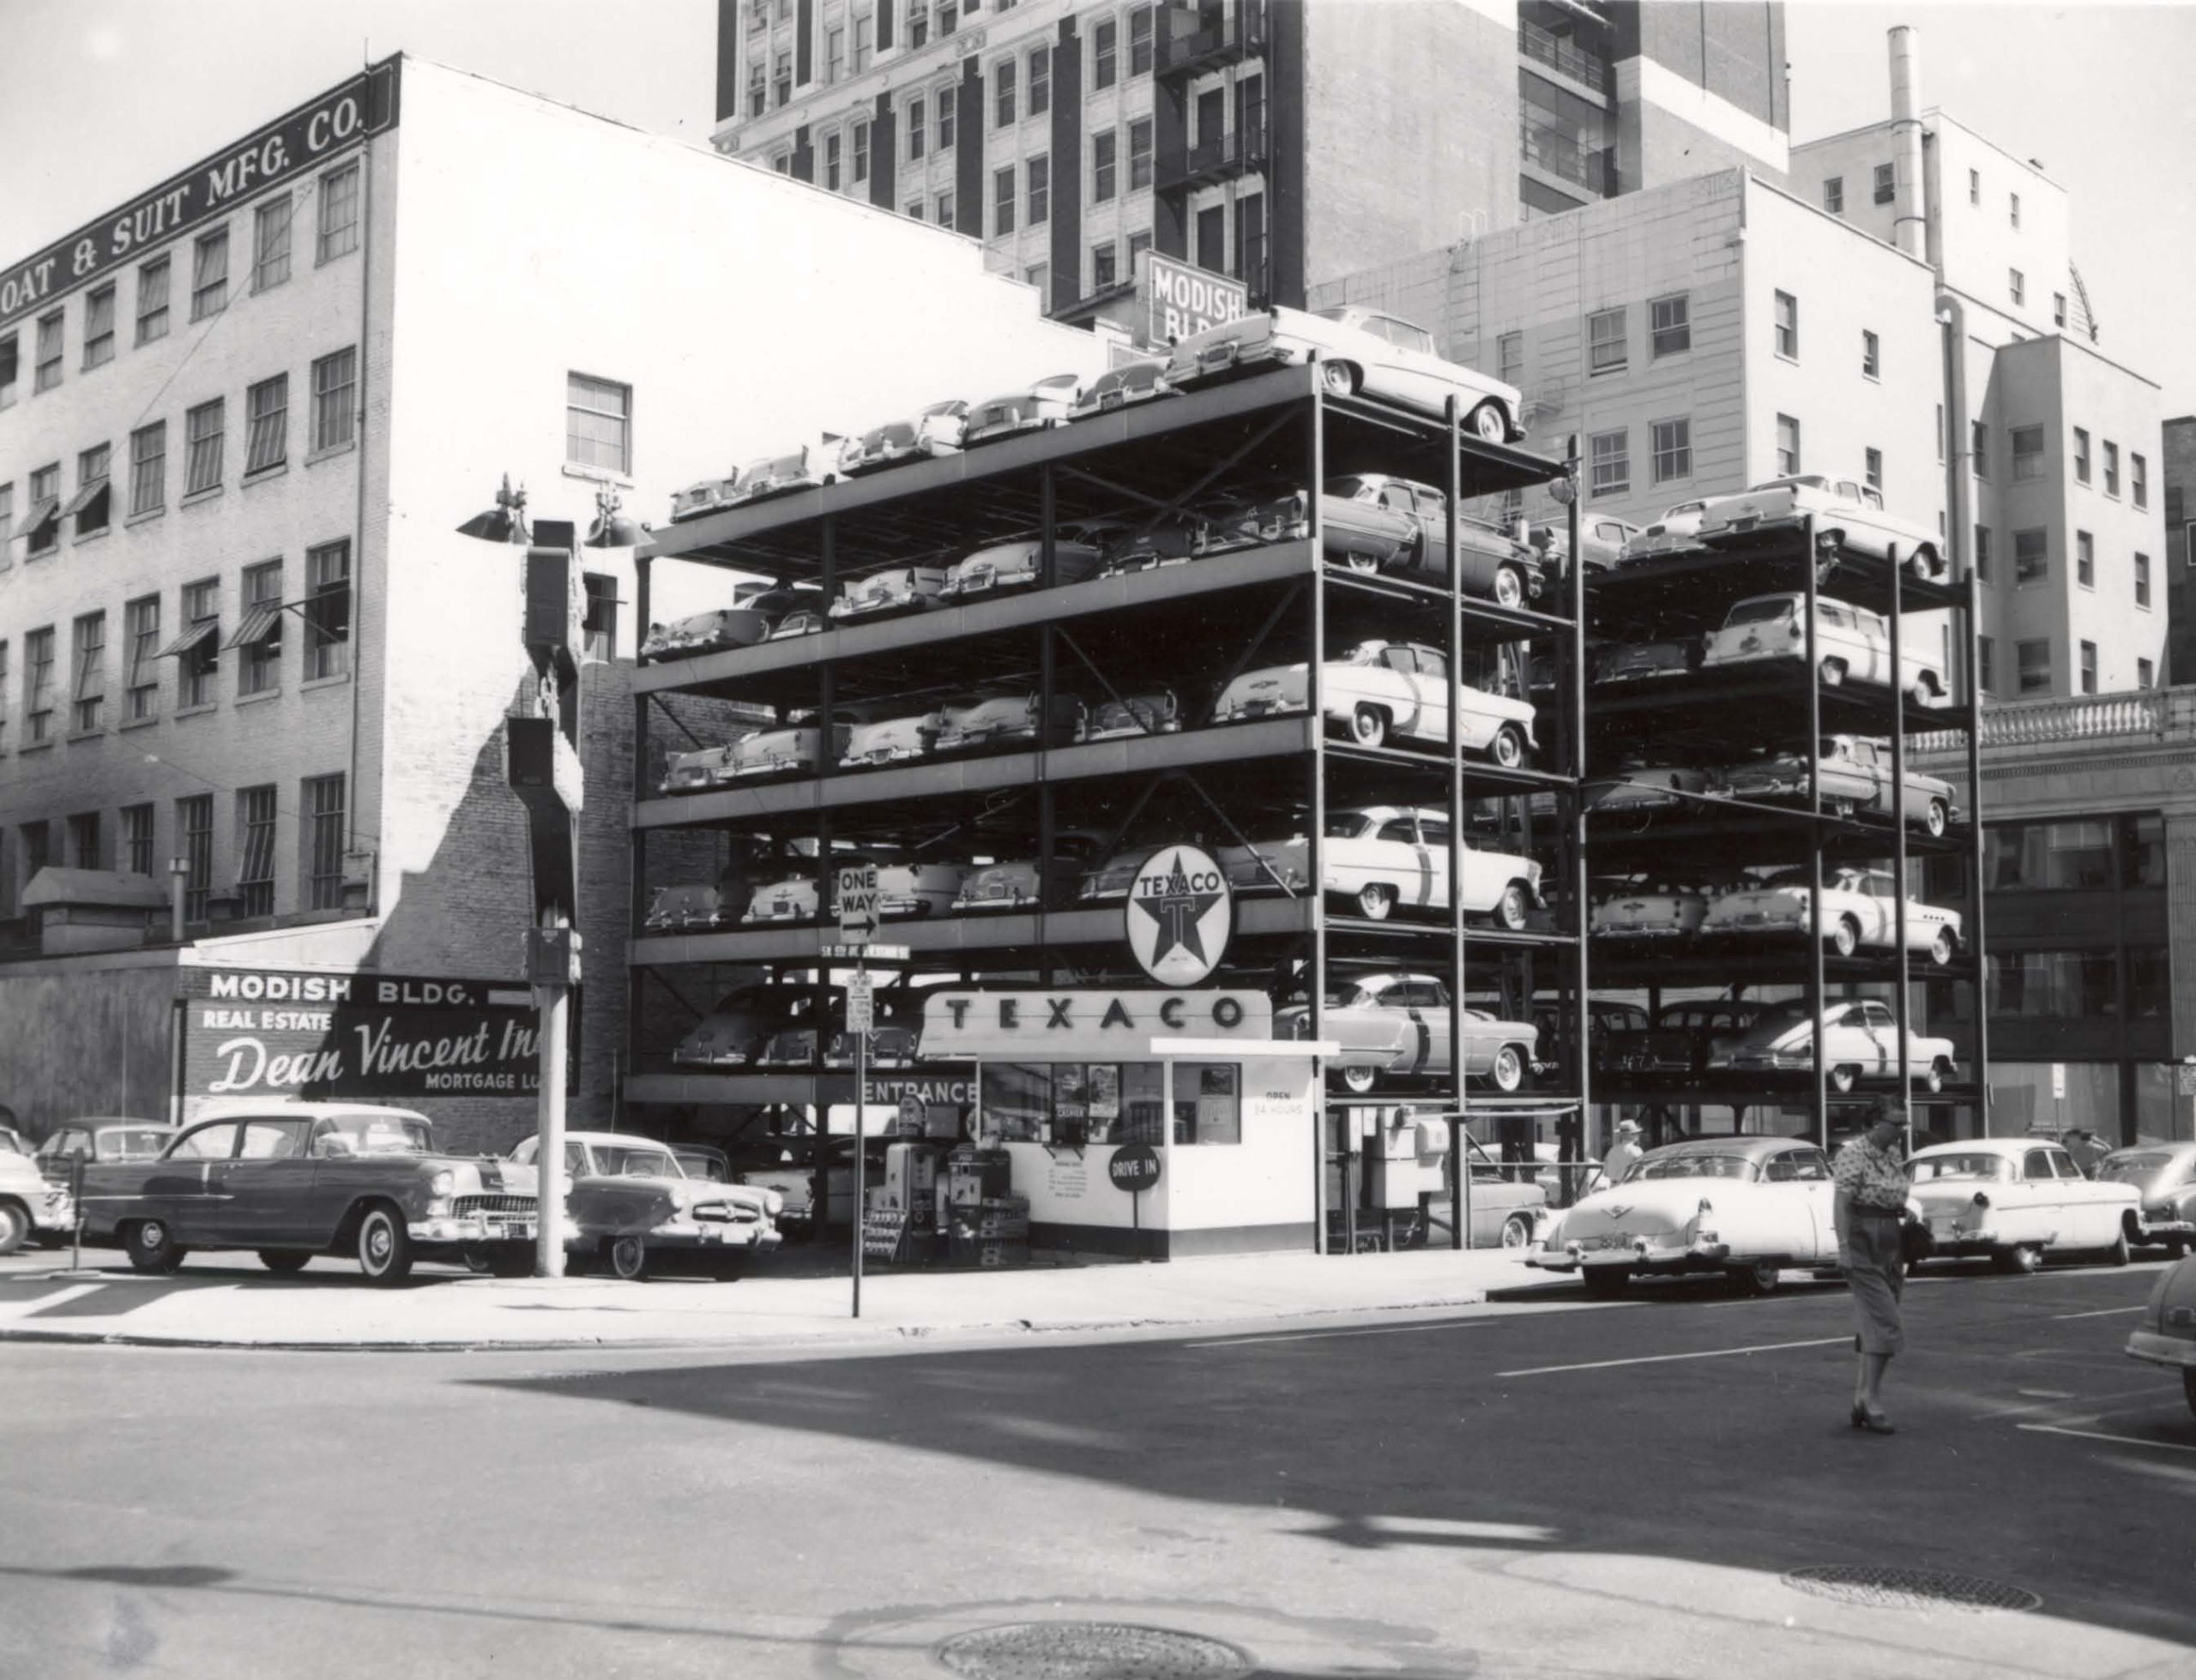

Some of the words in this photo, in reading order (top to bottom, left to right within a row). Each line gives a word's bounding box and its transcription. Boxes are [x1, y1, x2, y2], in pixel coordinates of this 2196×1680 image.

[1, 259, 55, 315] OAT
[72, 238, 97, 276] &
[112, 185, 190, 255] SUIT
[205, 135, 290, 208] MFG.
[307, 97, 365, 152] CO.
[1155, 266, 1241, 322] MODISH
[842, 870, 877, 891] ONE
[1139, 871, 1220, 897] TEXACO
[842, 893, 877, 913] WAY
[210, 974, 351, 1002] MODISH
[378, 982, 475, 1006] BLDG.
[203, 1009, 256, 1029] REAL
[262, 1011, 333, 1032] ESTATE
[945, 997, 1244, 1030] TEXACO
[208, 1036, 344, 1093] Dean
[354, 1016, 490, 1077] Vincent
[498, 1018, 541, 1061] In
[425, 1072, 515, 1090] MORTGAGE
[863, 1081, 979, 1104] ENTRANCE
[1112, 1159, 1140, 1177] DRIVE
[1144, 1158, 1157, 1176] IN
